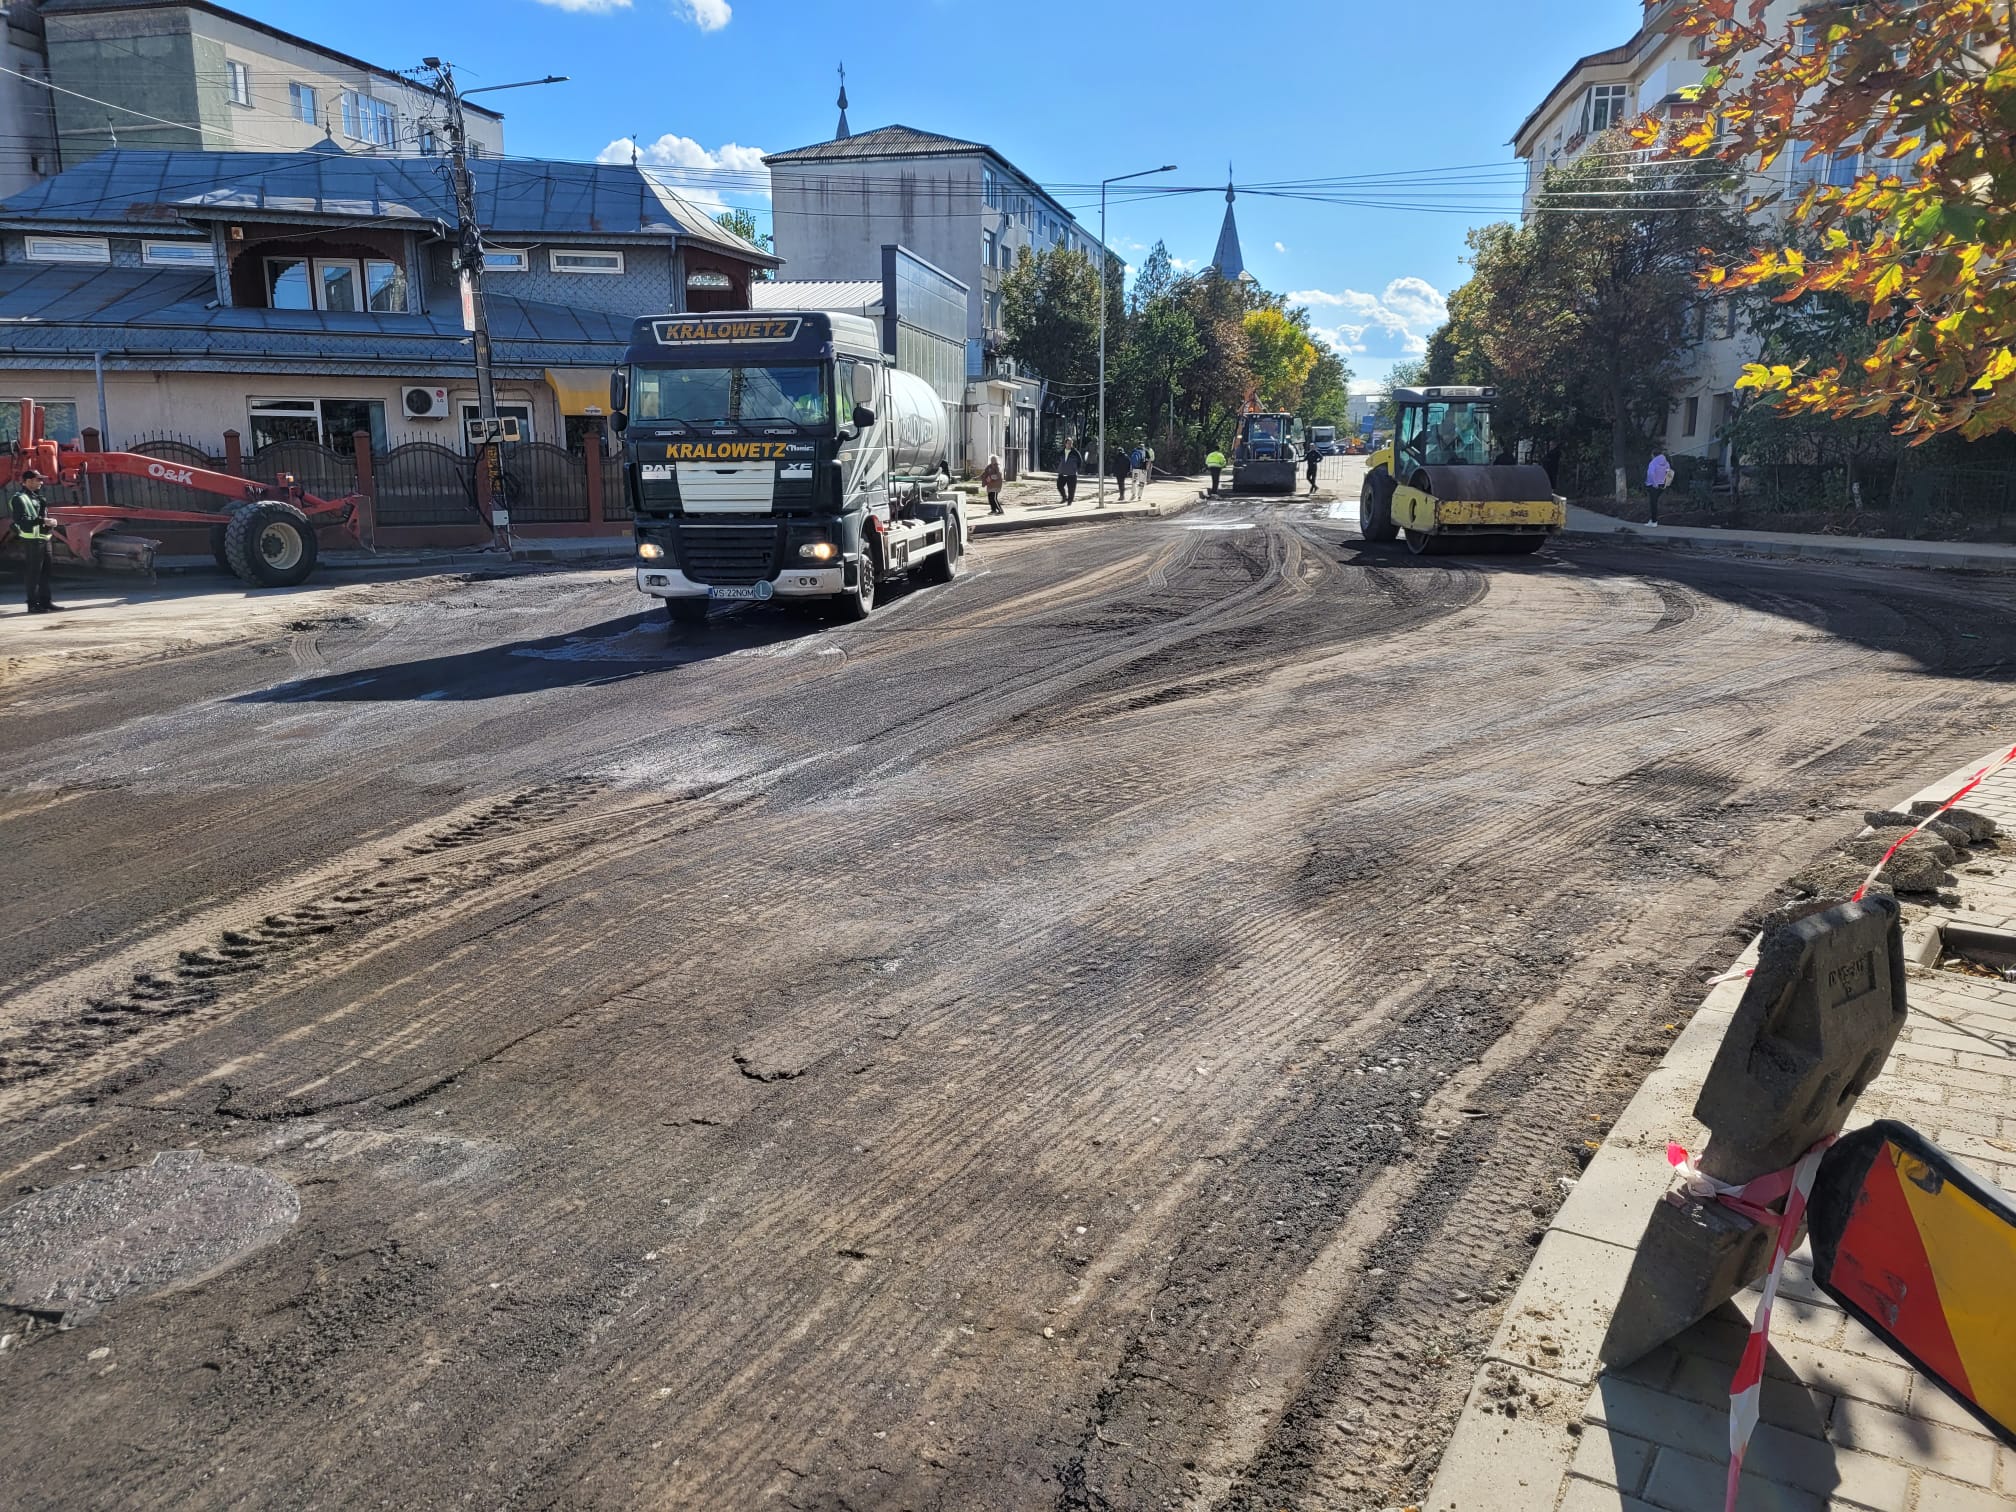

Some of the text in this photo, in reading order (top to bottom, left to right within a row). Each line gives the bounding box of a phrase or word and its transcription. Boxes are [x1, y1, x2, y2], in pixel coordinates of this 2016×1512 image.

[666, 322, 787, 339] KRALOWETZ
[666, 443, 787, 458] KRALOWETZ
[148, 463, 193, 485] O&K
[642, 464, 675, 472] DAF
